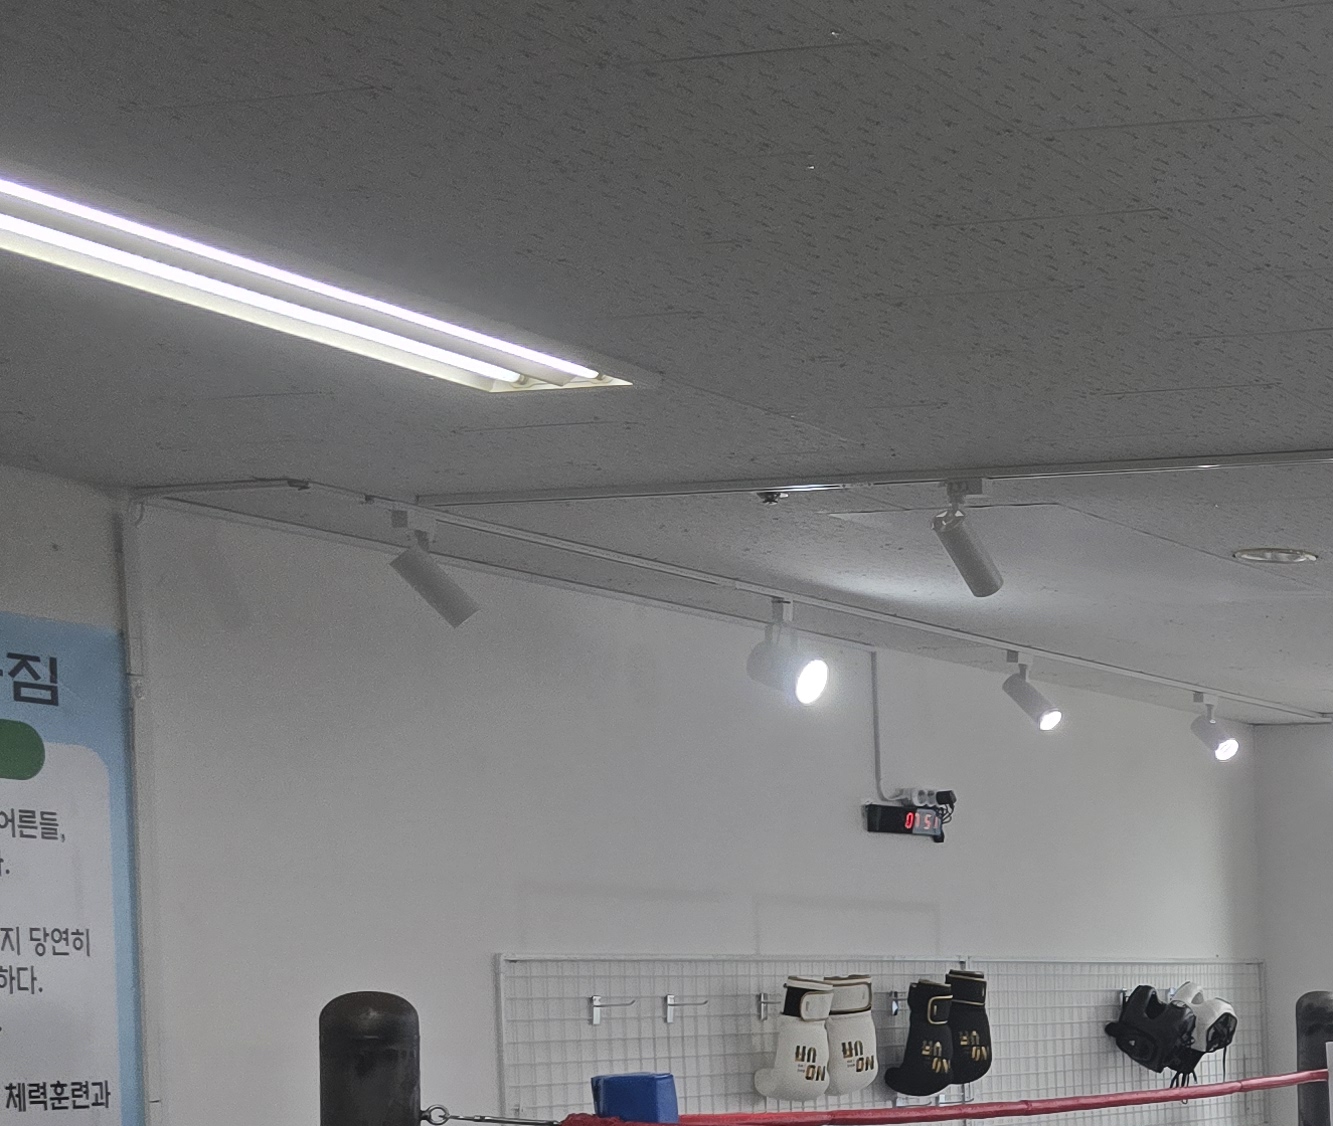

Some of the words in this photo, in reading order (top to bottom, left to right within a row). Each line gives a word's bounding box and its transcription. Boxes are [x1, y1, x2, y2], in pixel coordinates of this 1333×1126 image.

[0, 652, 59, 706] 짐
[0, 808, 65, 842] 어른들,
[29, 926, 91, 957] 당연히
[5, 1080, 111, 1112] 체력훈련과
